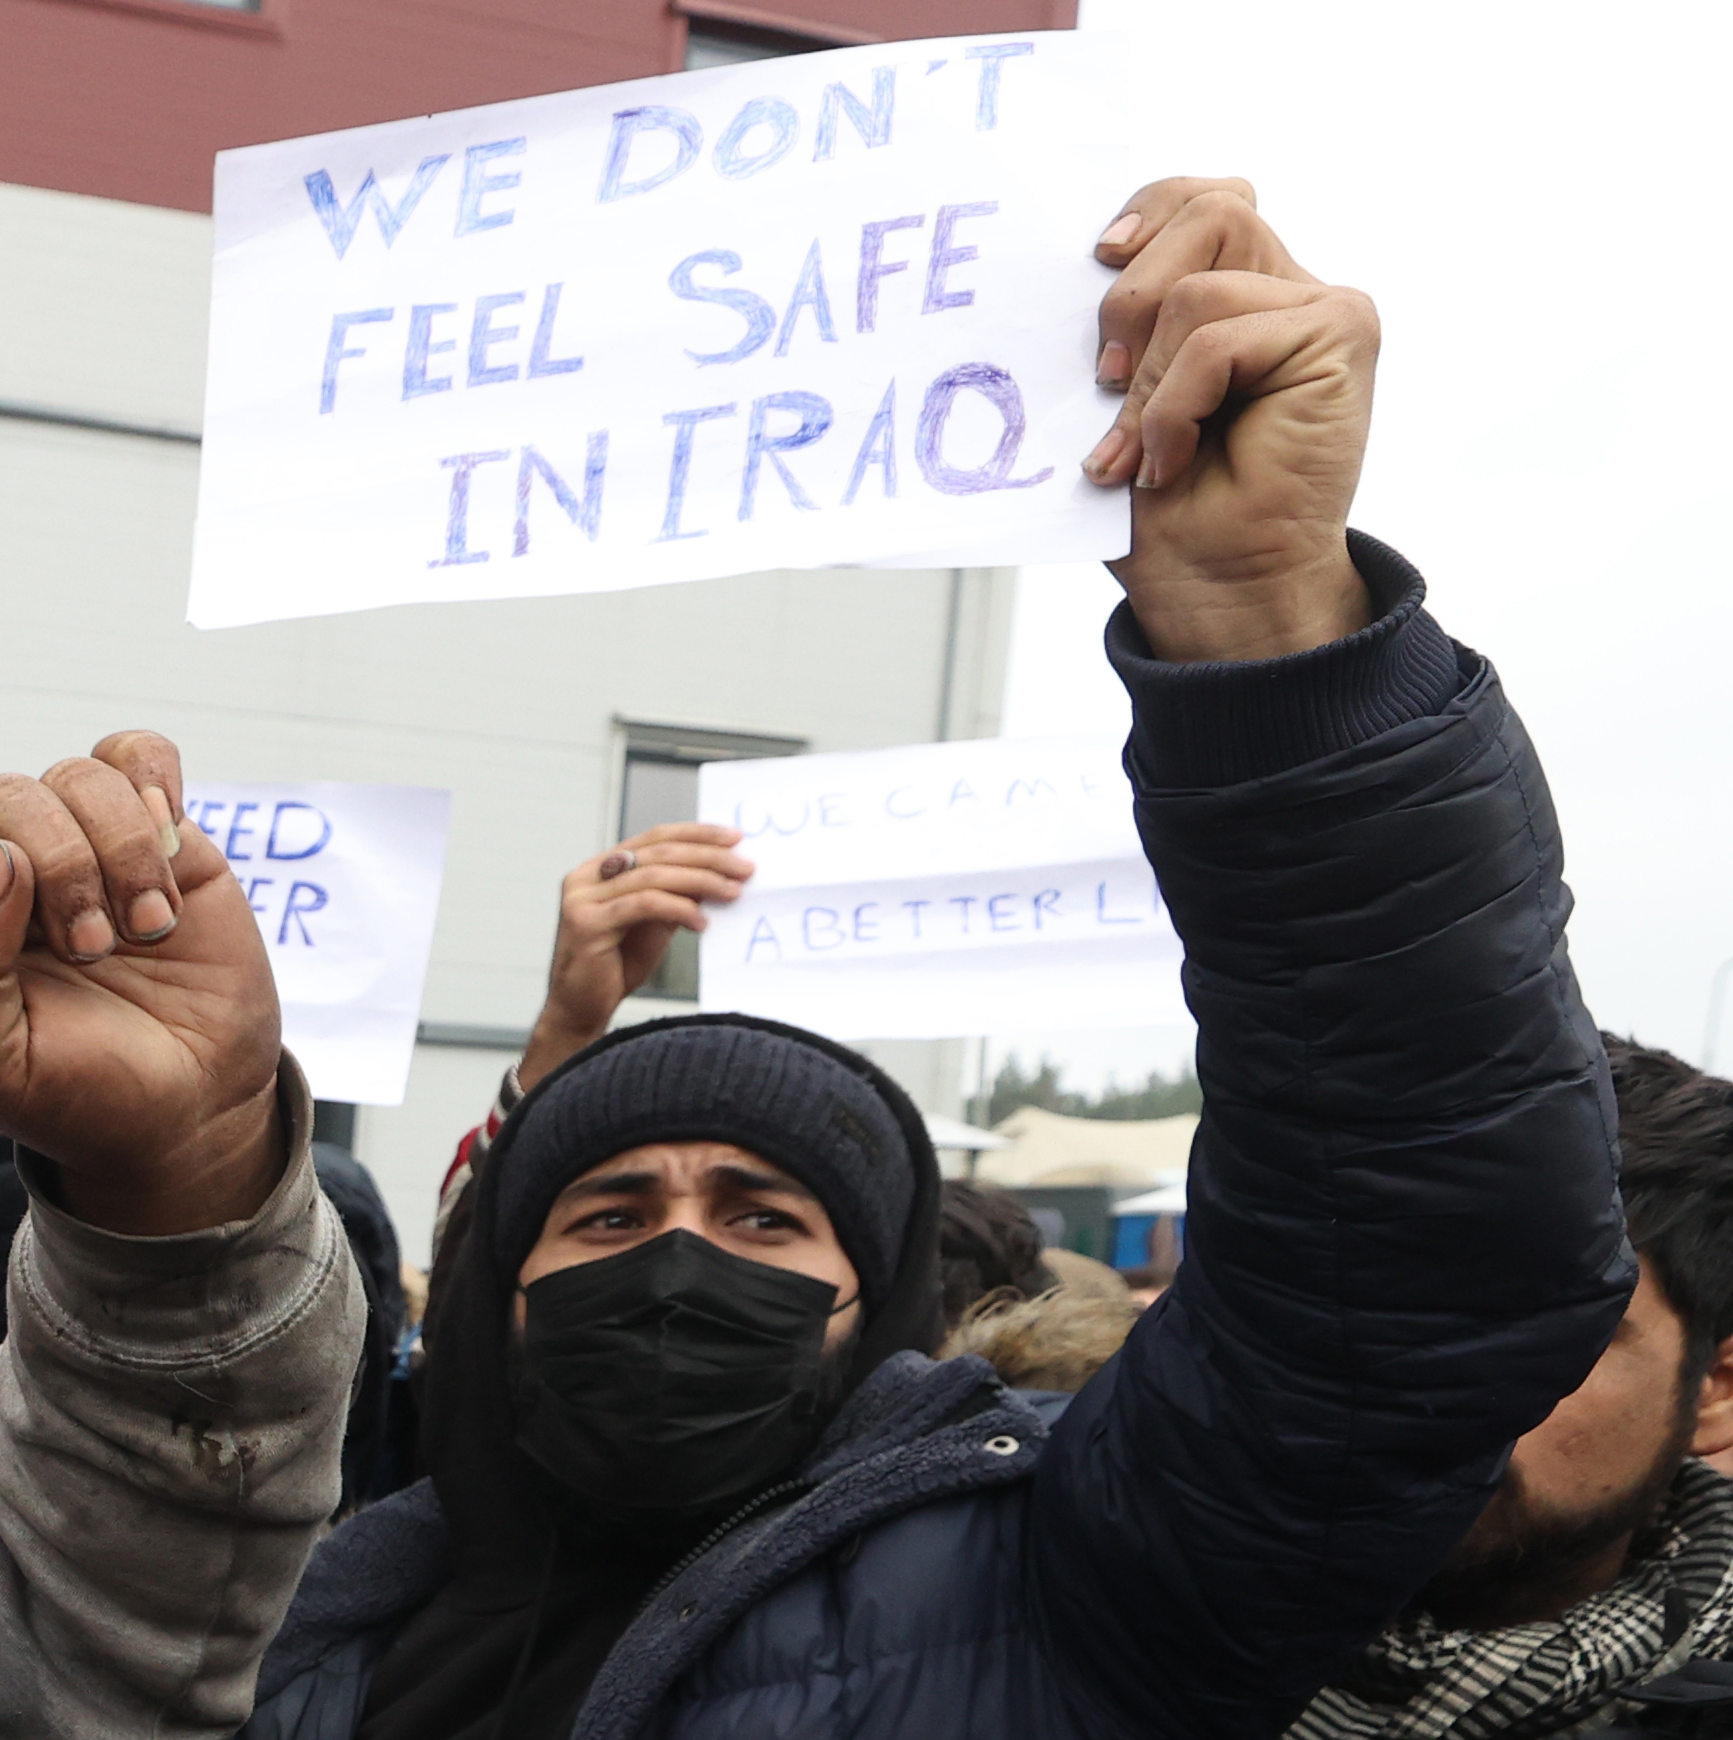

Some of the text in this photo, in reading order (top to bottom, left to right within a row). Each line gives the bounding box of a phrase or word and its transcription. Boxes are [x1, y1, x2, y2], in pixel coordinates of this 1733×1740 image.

[303, 41, 1035, 261] WE DON'T
[318, 200, 999, 415] FEEL SAFE
[427, 360, 1056, 570] IN IRAQ
[187, 800, 333, 862] EED
[734, 792, 851, 840] WE
[802, 887, 1064, 953] BETTER
